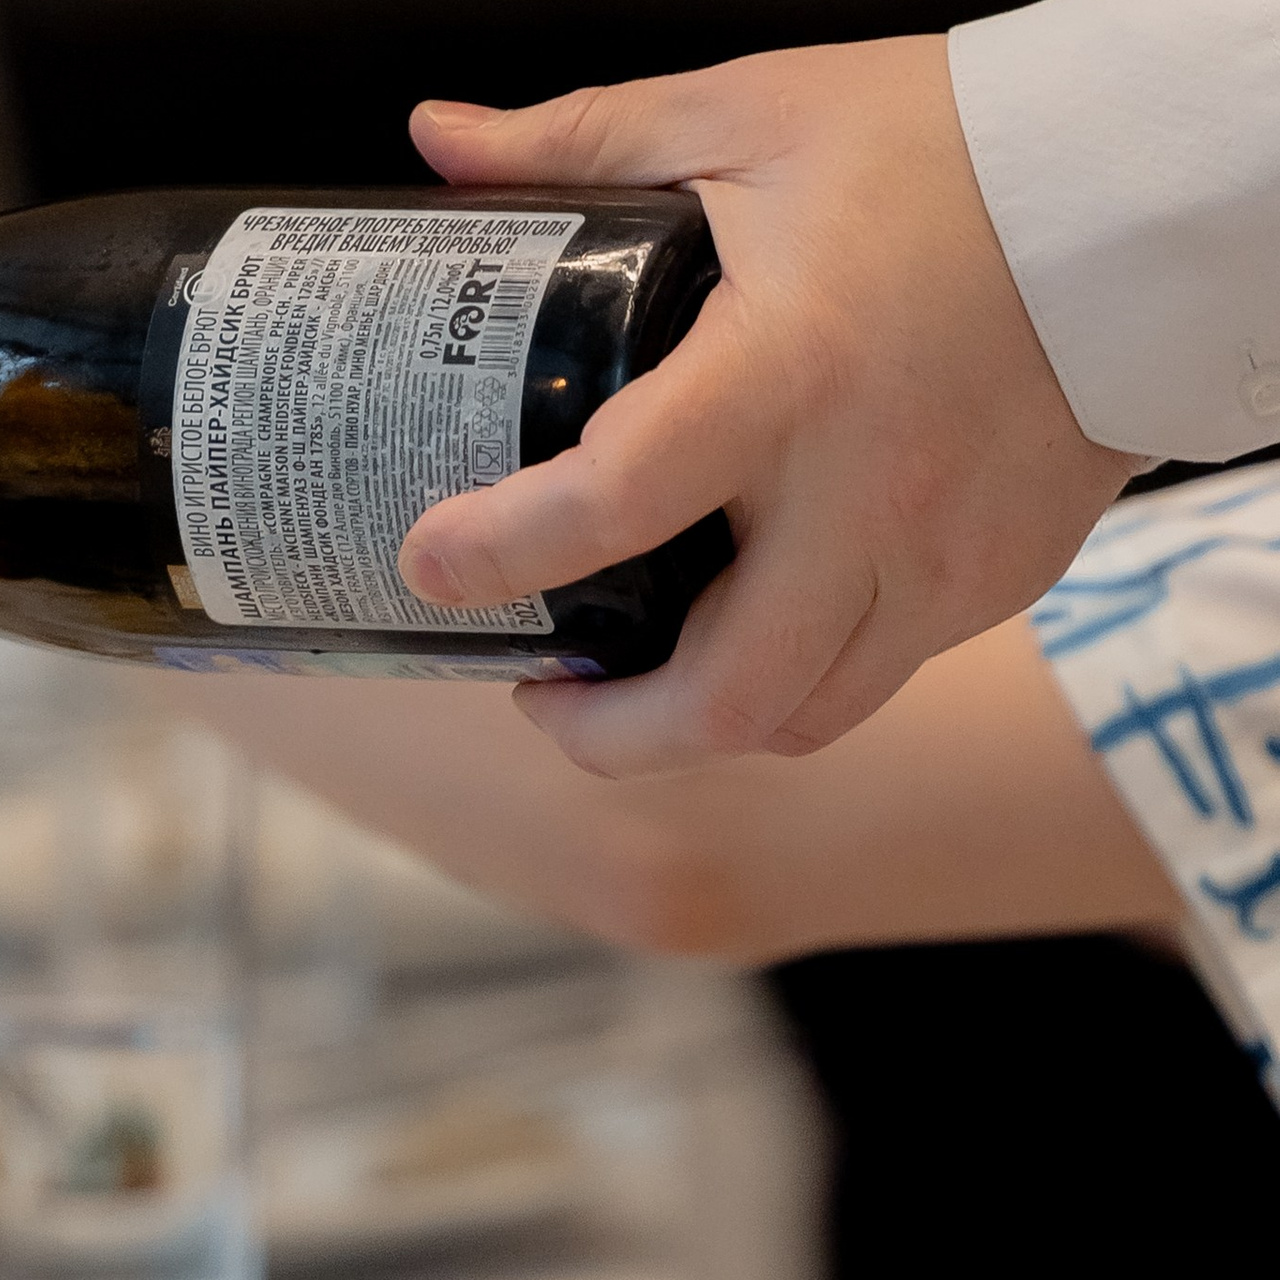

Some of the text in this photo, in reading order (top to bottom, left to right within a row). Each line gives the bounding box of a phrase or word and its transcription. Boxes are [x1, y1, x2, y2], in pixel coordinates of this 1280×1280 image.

[243, 215, 573, 236] ЧРЕЗМЕРНОЕ УПОТРЕБЛЕНИЕ АЛКОГОЛЯ
[269, 233, 519, 257] ВРЕДИТ ВАШЕМУ ЗДОРОВЬЮ!
[252, 256, 290, 307] ФРАНЦИЯ
[283, 258, 308, 289] PIPER
[315, 259, 342, 301] АНСЬЕН
[336, 259, 360, 288] 51100
[269, 296, 293, 338] PH-CH.
[291, 304, 307, 319] EN
[321, 291, 349, 340] Vignoble,
[235, 310, 273, 379] ШАМПАНЬ,
[281, 322, 302, 370] FONDEE
[318, 344, 332, 359] du
[349, 349, 366, 379] ПИНО
[258, 346, 280, 441] CHAMPENOISE
[290, 316, 322, 435] ПАЙПЕР-ХАЙДСИК
[232, 382, 255, 426] РЕГИОН
[275, 373, 293, 441] HEIDSIECK
[311, 394, 326, 407] 12
[328, 383, 343, 419] 51100
[346, 382, 363, 414] НУАР,
[181, 308, 219, 557] ВИНО ИГРИСТОЕ БЕЛОЕ БРЮТ
[205, 256, 264, 618] ШАМПАНЬ ПАЙПЕР-ХАЙДСИК БРЮТ
[327, 422, 342, 479] Винобль,
[345, 417, 358, 449] ПИНО
[232, 430, 256, 498] ВИНОГРАДА
[275, 446, 290, 497] MAISON
[292, 442, 306, 472] Ф-Ш
[310, 460, 323, 478] АН
[345, 458, 360, 496] СОРТОВ
[258, 450, 277, 535] «COMPAGNIE
[311, 482, 329, 528] ФОНДЕ
[331, 482, 345, 501] дю
[278, 500, 301, 561] ANCIENNE
[293, 478, 318, 558] ШАМПЕНУАЗ
[333, 502, 347, 532] Алле
[347, 499, 369, 555] ВИНОГРАДА
[235, 502, 276, 592] ПРОИСХОЖДЕНИЯ
[317, 531, 343, 586] ХАЙДСИК
[335, 534, 354, 552] (12
[340, 554, 362, 593] FRANCE
[292, 570, 324, 621] HEIDSIECK
[332, 589, 359, 623] МЕЗОН
[511, 595, 543, 628] 202
